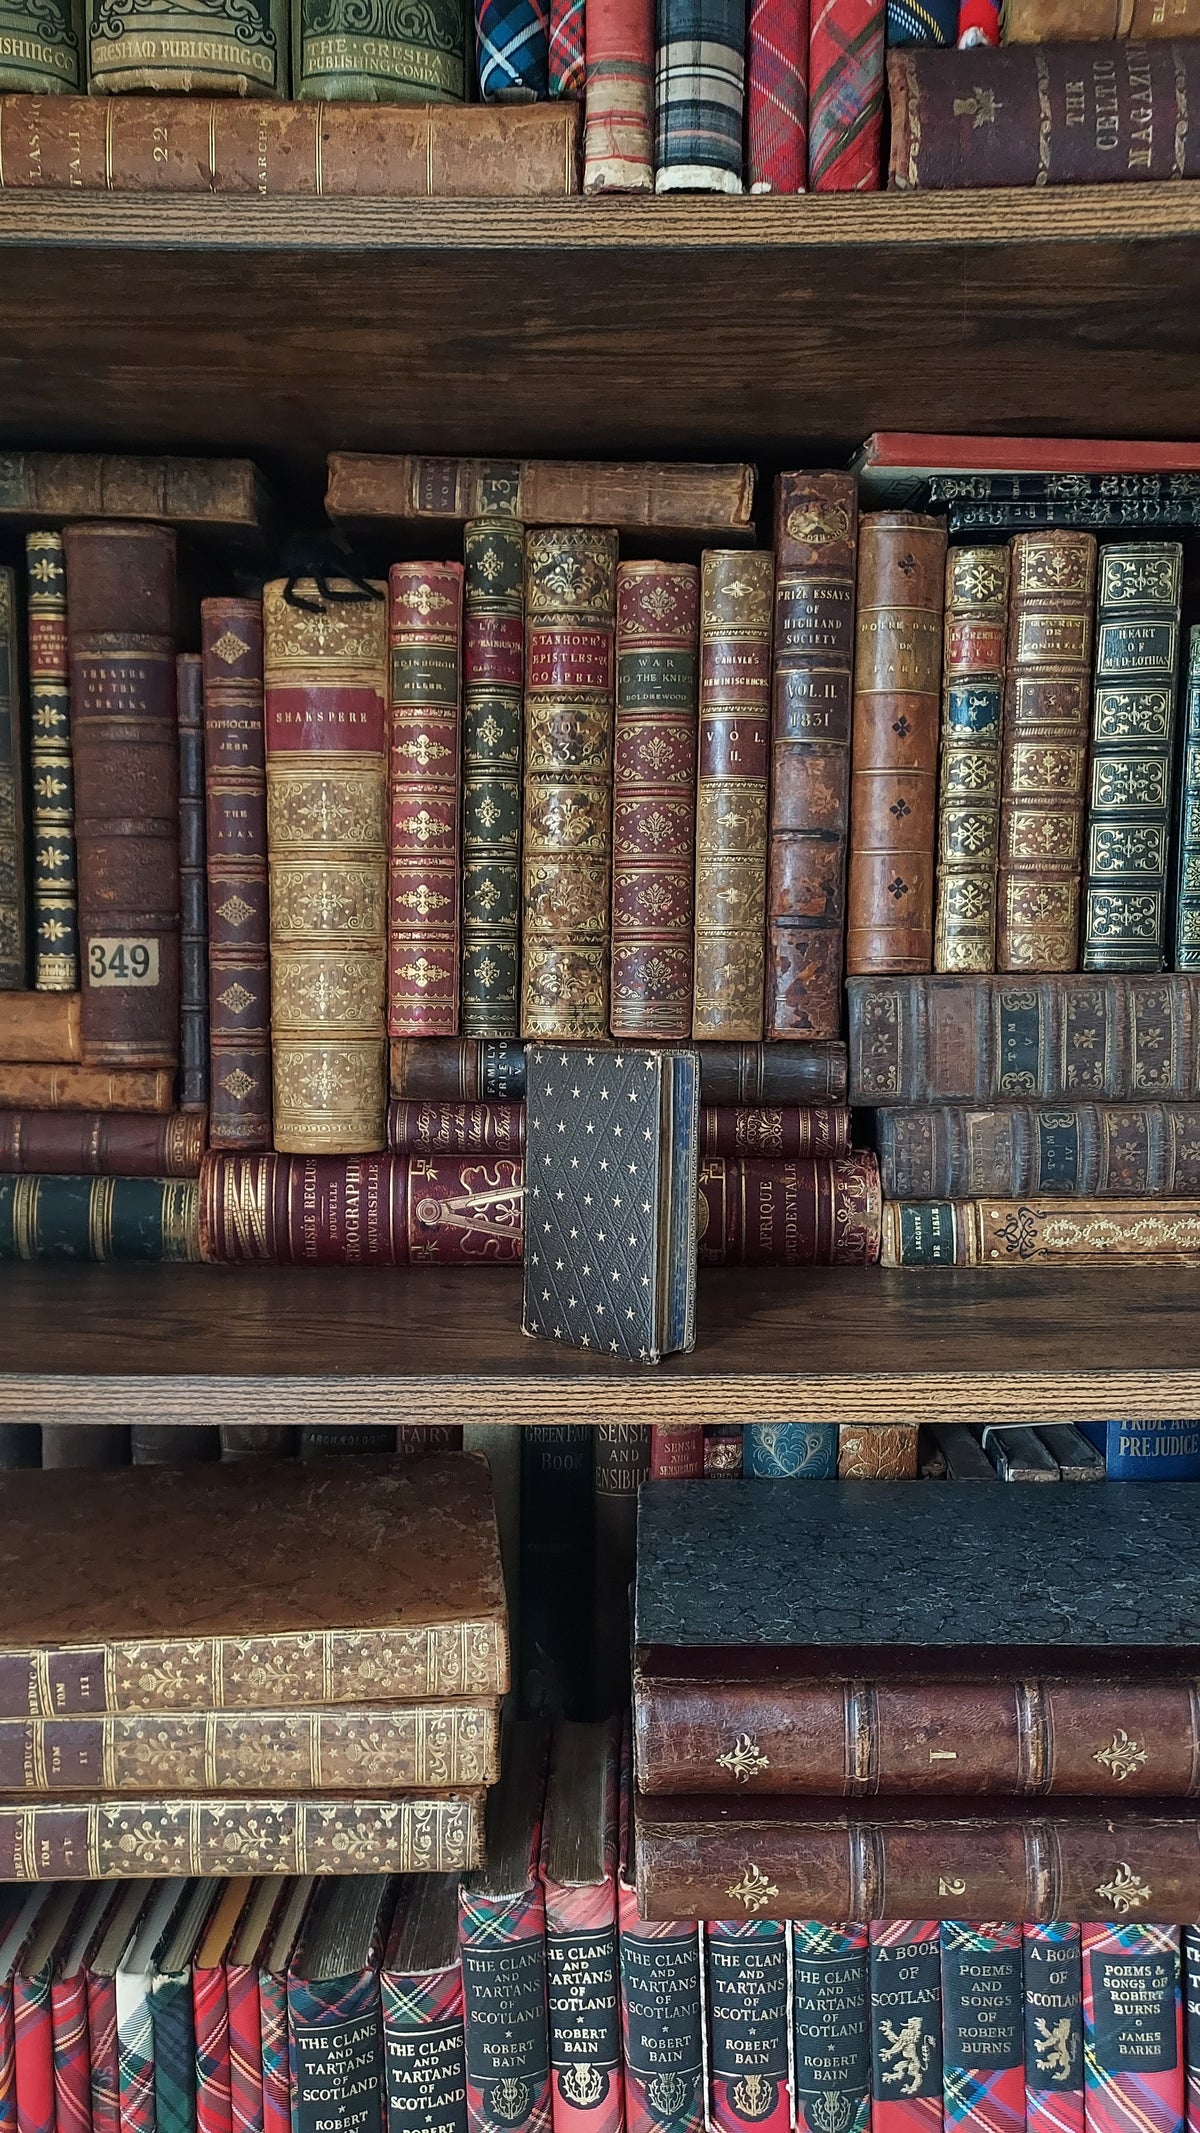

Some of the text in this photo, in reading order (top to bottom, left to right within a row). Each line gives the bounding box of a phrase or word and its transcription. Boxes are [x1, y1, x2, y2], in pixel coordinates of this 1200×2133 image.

[307, 38, 348, 55] THE
[93, 40, 272, 73] GRESHAM PUBLISHING CO
[308, 54, 391, 73] PUBLISHING
[1065, 80, 1085, 128] THE
[1093, 60, 1119, 150] CELTIC
[152, 126, 168, 163] 22
[777, 586, 851, 601] PRIZE ESSAYS
[805, 605, 821, 614] OF
[783, 618, 843, 630] HIGHLAND
[785, 634, 838, 645] SOCIETY
[1118, 628, 1156, 640] HEART
[1127, 642, 1145, 652] OF
[532, 653, 593, 665] EPISTLES
[638, 658, 675, 668] WAR
[1103, 655, 1170, 668] MID-LOTHIAN
[532, 671, 604, 684] GOSPELS
[637, 673, 657, 682] THE
[626, 693, 687, 701] BOLDREWOOD
[275, 711, 368, 724] SHAKSPERE
[790, 711, 830, 728] 1831
[223, 809, 248, 819] THE
[217, 830, 255, 839] AJAX
[90, 944, 151, 979] 349
[1007, 1022, 1017, 1062] TOM
[487, 1044, 496, 1094] FAMILY
[498, 1041, 508, 1098] FRIEND
[514, 1067, 522, 1075] V
[1047, 1134, 1056, 1170] TOM
[304, 1158, 317, 1210] RECLUS
[329, 1181, 339, 1240] NOUVELLE
[367, 1164, 379, 1254] UNIVERSELLE
[759, 1180, 776, 1251] AFRIQUE
[931, 1208, 940, 1258] DE LISLE
[1118, 1433, 1199, 1457] PREJUDICE
[608, 1449, 640, 1462] AND
[56, 1682, 66, 1707] TOM
[52, 1745, 62, 1774] TOM
[79, 1750, 88, 1764] II
[41, 1839, 51, 1868] TOM
[938, 1877, 967, 1897] 2
[568, 1941, 614, 1960] CLANS
[624, 1947, 698, 1967] THE CLANS
[875, 1940, 940, 1962] A BOOK
[1030, 1946, 1042, 1961] A
[466, 1951, 543, 1973] THE CLANS
[562, 1961, 590, 1972] AND
[711, 1952, 741, 1967] THE
[494, 1972, 520, 1983] AND
[649, 1969, 676, 1978] AND
[737, 1969, 765, 1979] AND
[898, 1966, 920, 1980] OF
[959, 1965, 1013, 1977] POEMS
[1104, 1965, 1165, 1976] POEMS &
[629, 1975, 698, 1993] TARTANS
[1049, 1971, 1068, 1985] OF
[1103, 1977, 1169, 1989] SONGS OF
[472, 1978, 542, 1999] TARTANS
[569, 1986, 586, 1997] OF
[715, 1977, 785, 1995] TARTANS
[817, 1986, 844, 1996] AND
[971, 1981, 1002, 1992] AND
[655, 1995, 672, 2005] OF
[743, 1996, 760, 2007] OF
[796, 1993, 865, 2011] TARTANS
[960, 1996, 1012, 2007] SONGS
[1026, 1990, 1081, 2008] SCOTLAN
[1110, 1990, 1164, 2001] ROBERT
[499, 2000, 515, 2009] OF
[548, 1995, 616, 2012] COTLAND
[628, 2000, 699, 2020] SCOTLAND
[1113, 2004, 1161, 2015] BURNS
[470, 2005, 544, 2025] SCOTLAND
[713, 2004, 786, 2022] SCOTLAND
[822, 2013, 839, 2023] OF
[977, 2012, 997, 2023] OF
[299, 2023, 377, 2050] THE CLANS
[553, 2028, 608, 2039] ROBERT
[958, 2027, 1016, 2038] ROBERT
[1118, 2031, 1162, 2043] JAMES
[387, 2035, 464, 2057] THE CLANS
[482, 2038, 536, 2055] ROBERT
[564, 2041, 599, 2053] BAIN
[640, 2034, 692, 2049] ROBERT
[725, 2036, 780, 2051] ROBERT
[960, 2042, 1012, 2054] BURNS
[327, 2048, 354, 2060] AND
[649, 2050, 683, 2063] BAIN
[1118, 2044, 1162, 2055] BARKE
[304, 2051, 375, 2075] TARTANS
[413, 2056, 440, 2068] AND
[492, 2055, 527, 2068] BAIN
[735, 2053, 770, 2065] BAIN
[804, 2053, 858, 2067] ROBERT
[391, 2062, 462, 2084] TARTANS
[813, 2069, 848, 2081] BAIN
[332, 2075, 349, 2086] OF
[302, 2076, 379, 2101] SCOTLAND
[419, 2084, 436, 2094] OF
[390, 2088, 466, 2111] SCOTLAND
[315, 2110, 369, 2131] ROBERT
